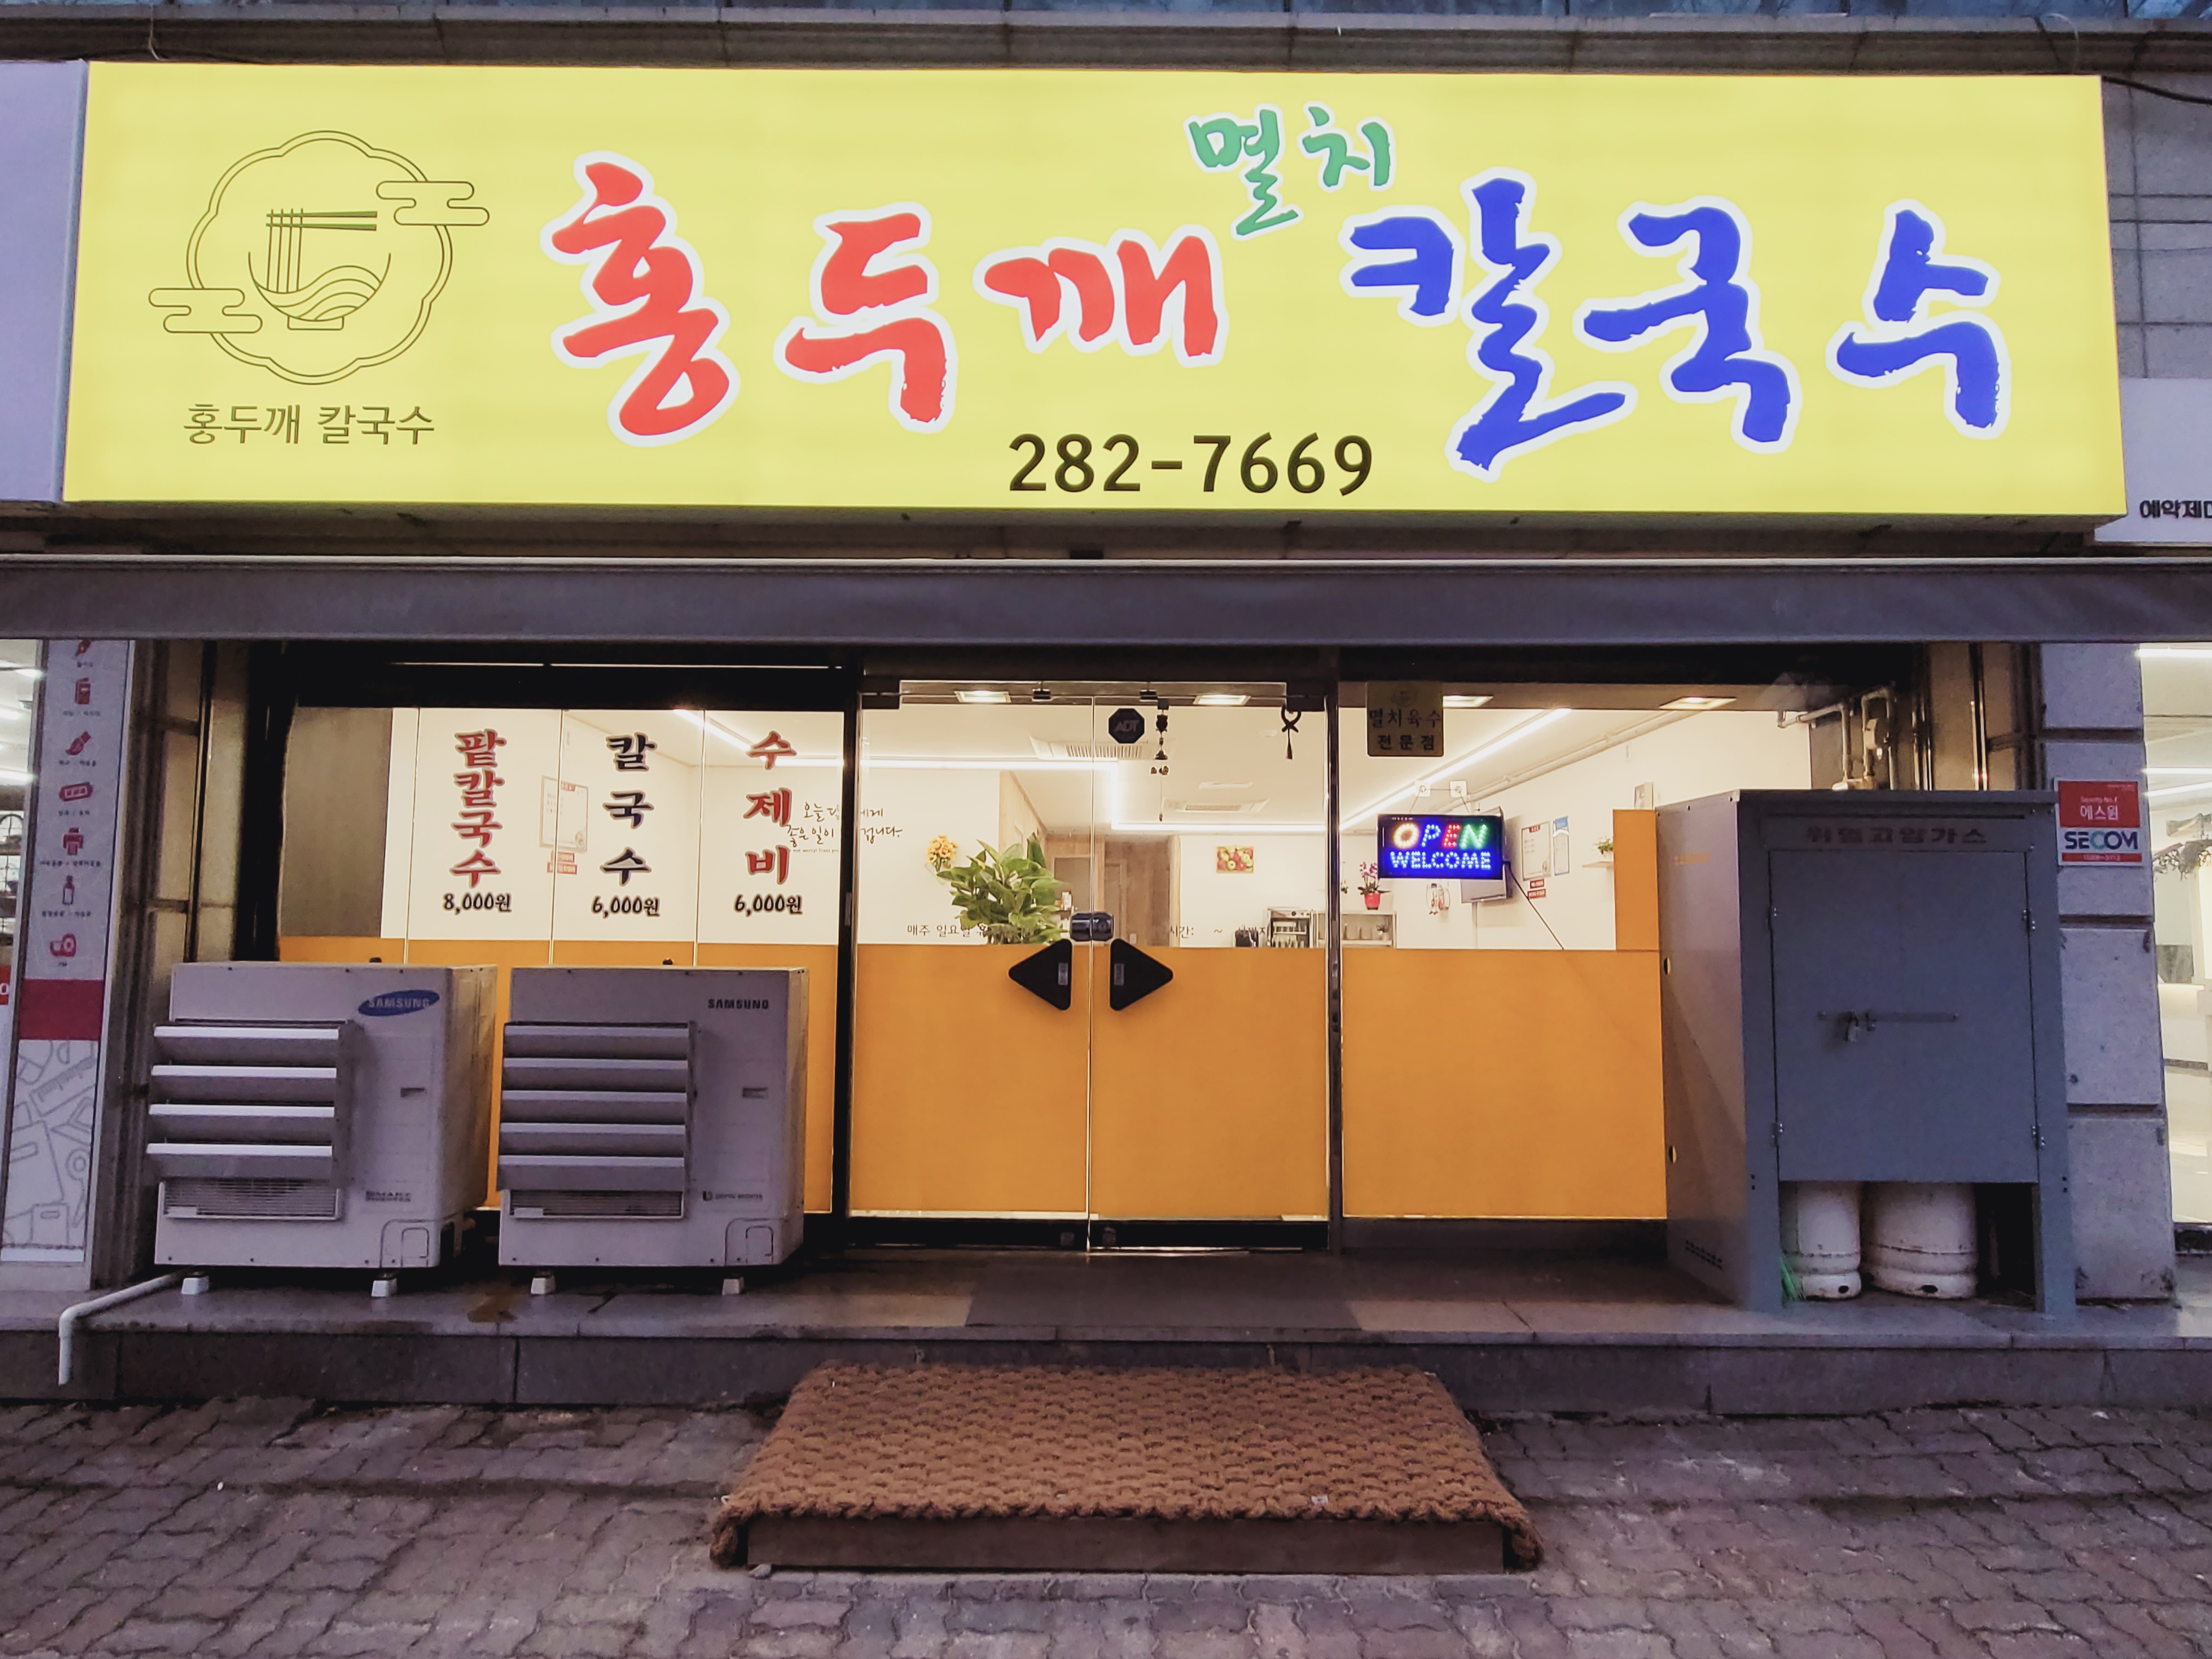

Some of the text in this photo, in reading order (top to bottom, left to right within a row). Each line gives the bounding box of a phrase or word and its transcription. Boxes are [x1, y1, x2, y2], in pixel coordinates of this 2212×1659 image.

[1188, 106, 1392, 236] 멸치
[550, 161, 2002, 472] 홍두깨 칼국수
[183, 403, 435, 445] 홍두깨 칼국수
[1008, 432, 1373, 496] 282-7669
[1113, 719, 1139, 732] ADT
[1377, 734, 1435, 751] 전문점
[449, 728, 507, 889] 팥칼국수
[600, 732, 658, 887] 칼국수
[743, 730, 798, 885] 수제비
[803, 801, 825, 822] 오늘
[2080, 804, 2119, 821] 에스원
[811, 825, 834, 845] 일이
[1393, 822, 1488, 849] OPEN
[2064, 830, 2138, 850] SECOM
[1389, 850, 1492, 870] WELCOME
[442, 891, 512, 916] 8,000원
[591, 895, 661, 919] 6,000원
[733, 893, 803, 917] 6,000원
[907, 924, 930, 936] 매주
[368, 997, 430, 1008] SAMSUNG
[708, 998, 769, 1009] SAMSUNG
